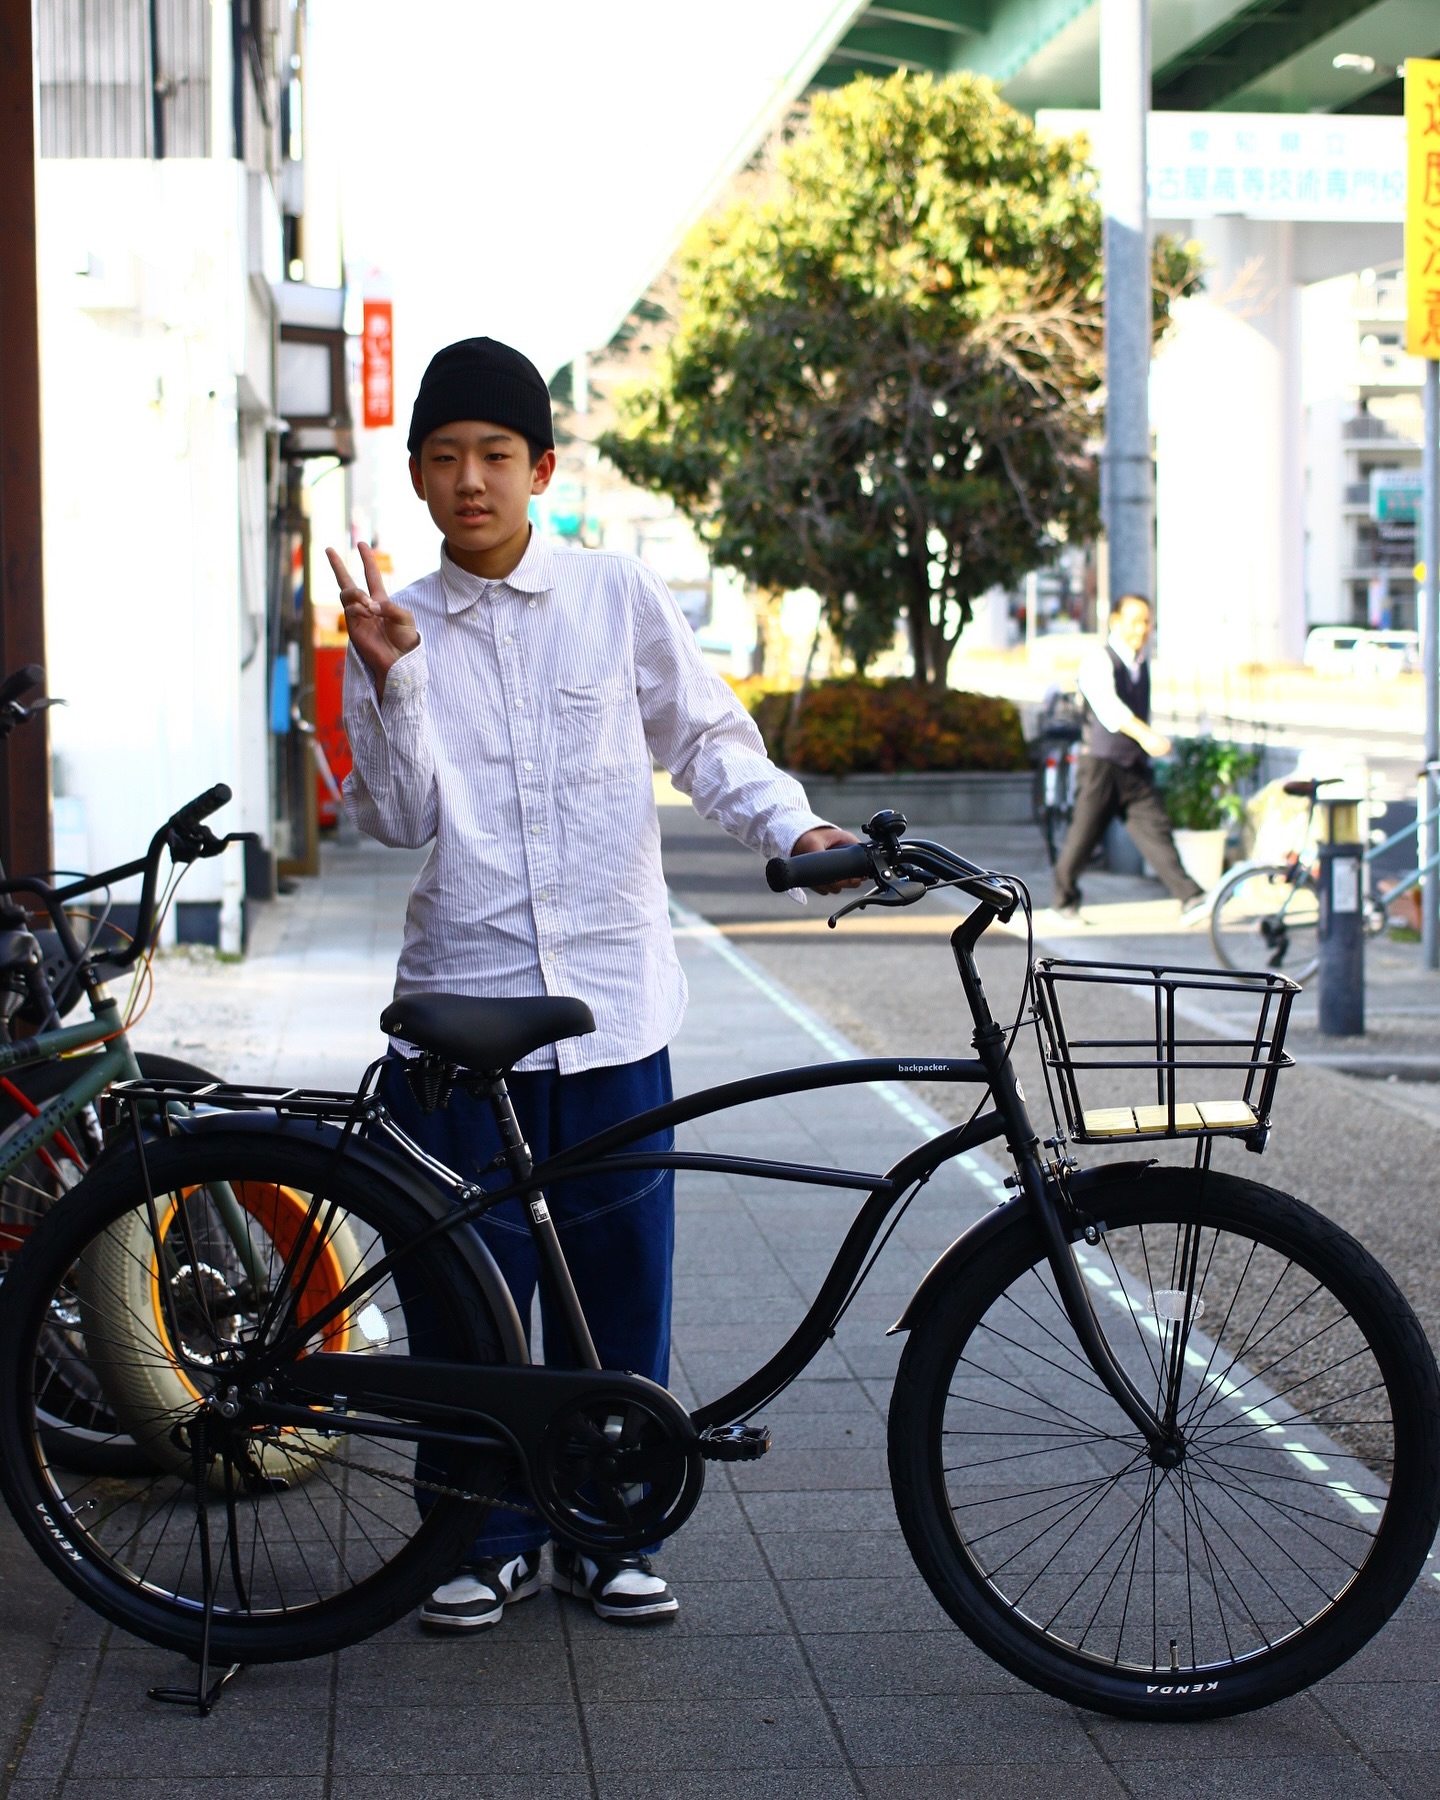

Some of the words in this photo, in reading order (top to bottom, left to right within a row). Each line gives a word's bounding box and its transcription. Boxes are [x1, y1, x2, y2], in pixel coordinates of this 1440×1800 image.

[1147, 165, 1405, 202] 古屋高等技術専門校
[898, 1063, 950, 1073] backpacker.
[36, 1503, 83, 1561] KENDA
[1146, 1681, 1219, 1694] KENDA
